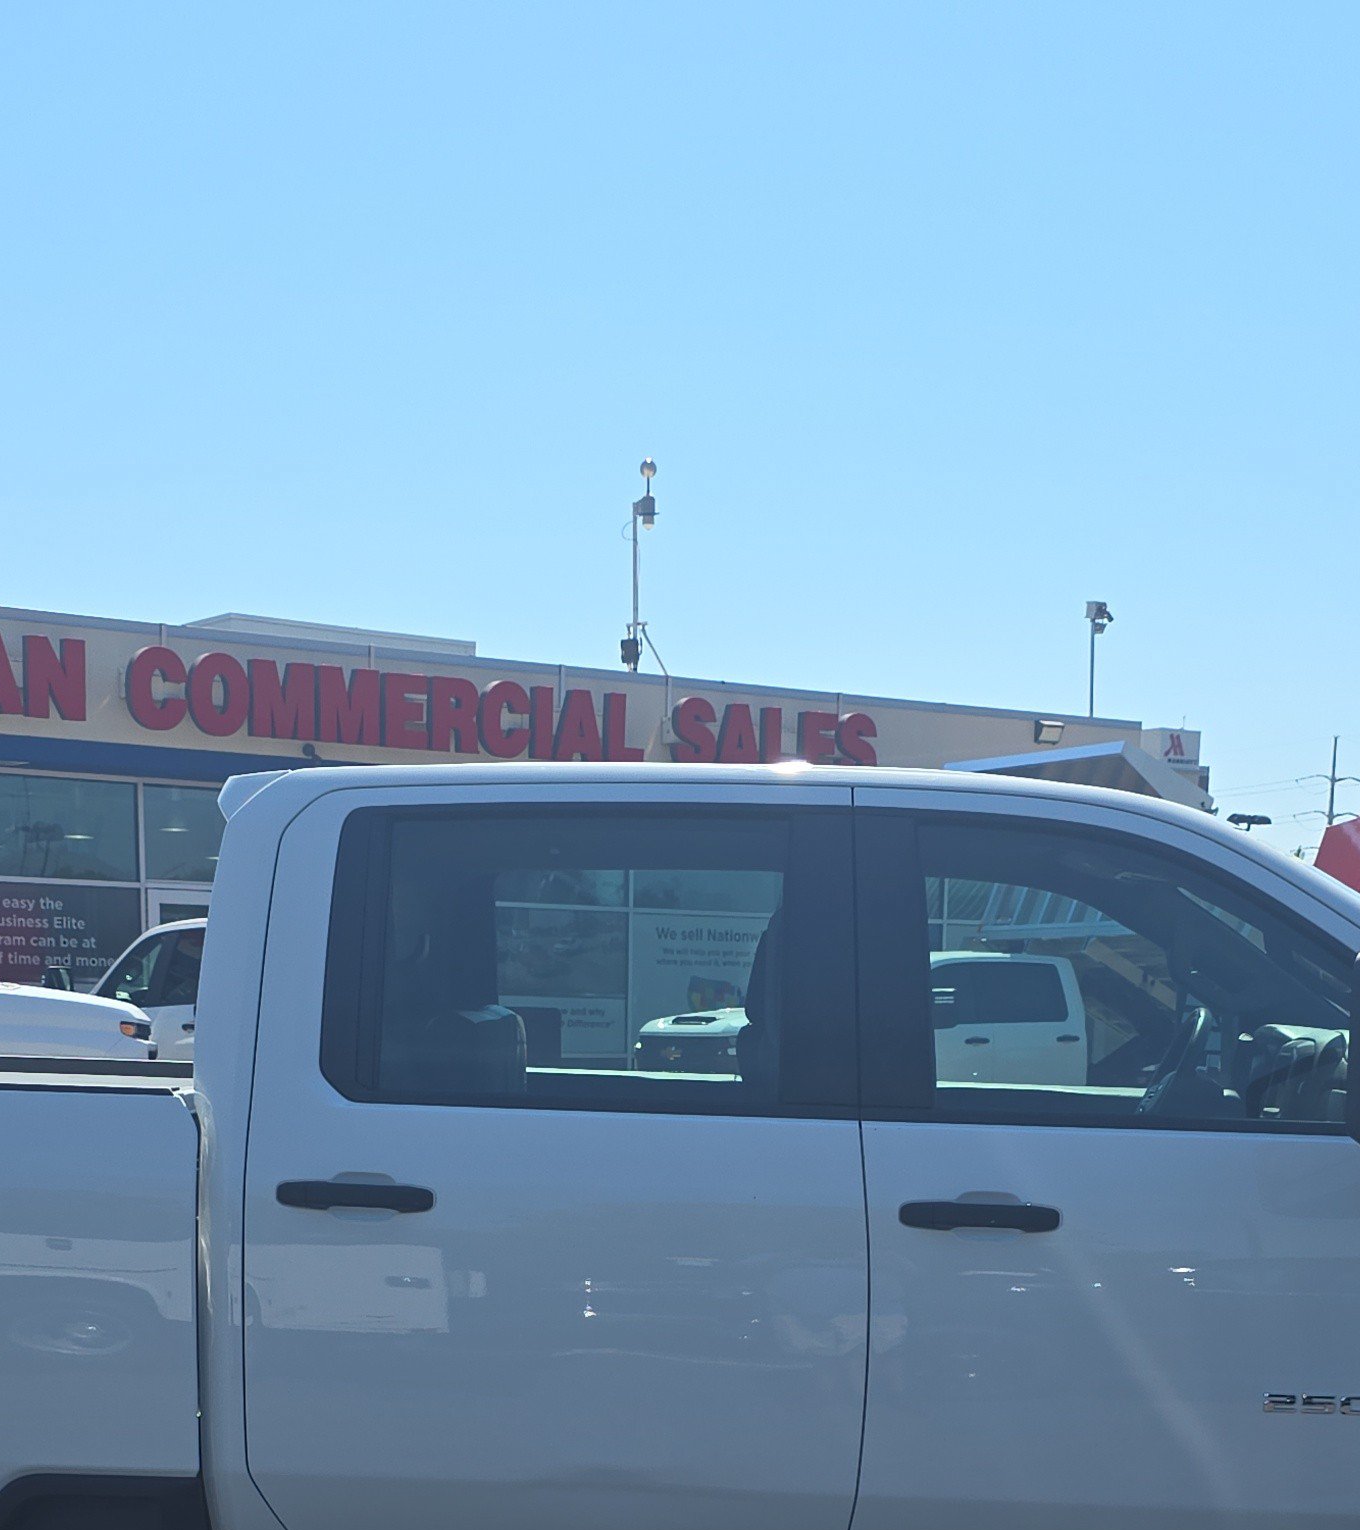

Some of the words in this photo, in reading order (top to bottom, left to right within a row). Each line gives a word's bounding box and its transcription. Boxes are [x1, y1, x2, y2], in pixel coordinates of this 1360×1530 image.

[125, 645, 644, 762] COMMERCIAL
[670, 697, 878, 767] SALES
[2, 897, 35, 911] easy
[39, 897, 64, 911] the
[53, 916, 86, 930] Elite
[655, 927, 677, 940] We
[681, 928, 703, 941] sell
[706, 929, 761, 942] Nationw
[30, 935, 55, 947] can
[59, 935, 78, 948] be
[81, 937, 96, 949] at
[7, 952, 40, 966] time
[44, 953, 70, 966] and
[75, 956, 116, 967] mone
